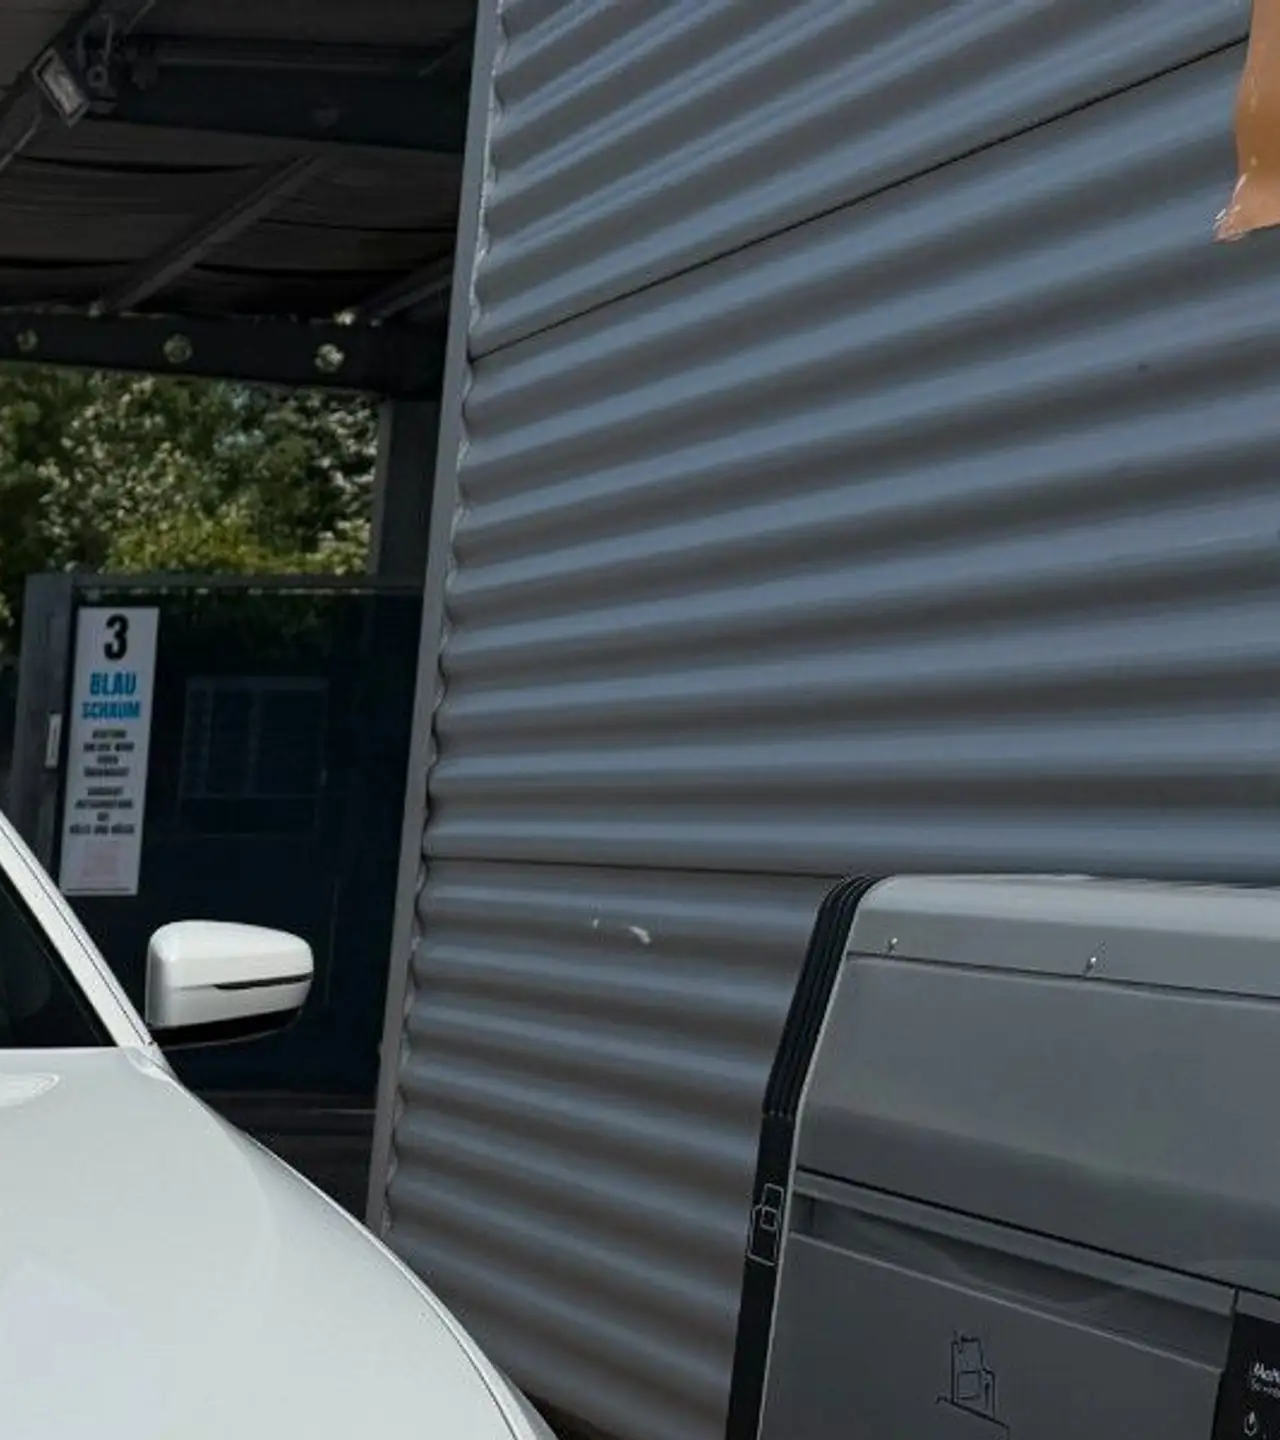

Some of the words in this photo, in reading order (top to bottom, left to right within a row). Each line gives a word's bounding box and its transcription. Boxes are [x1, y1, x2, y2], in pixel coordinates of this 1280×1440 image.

[104, 613, 129, 660] 3
[90, 672, 136, 695] BLAU
[81, 700, 141, 719] SCHAUM
